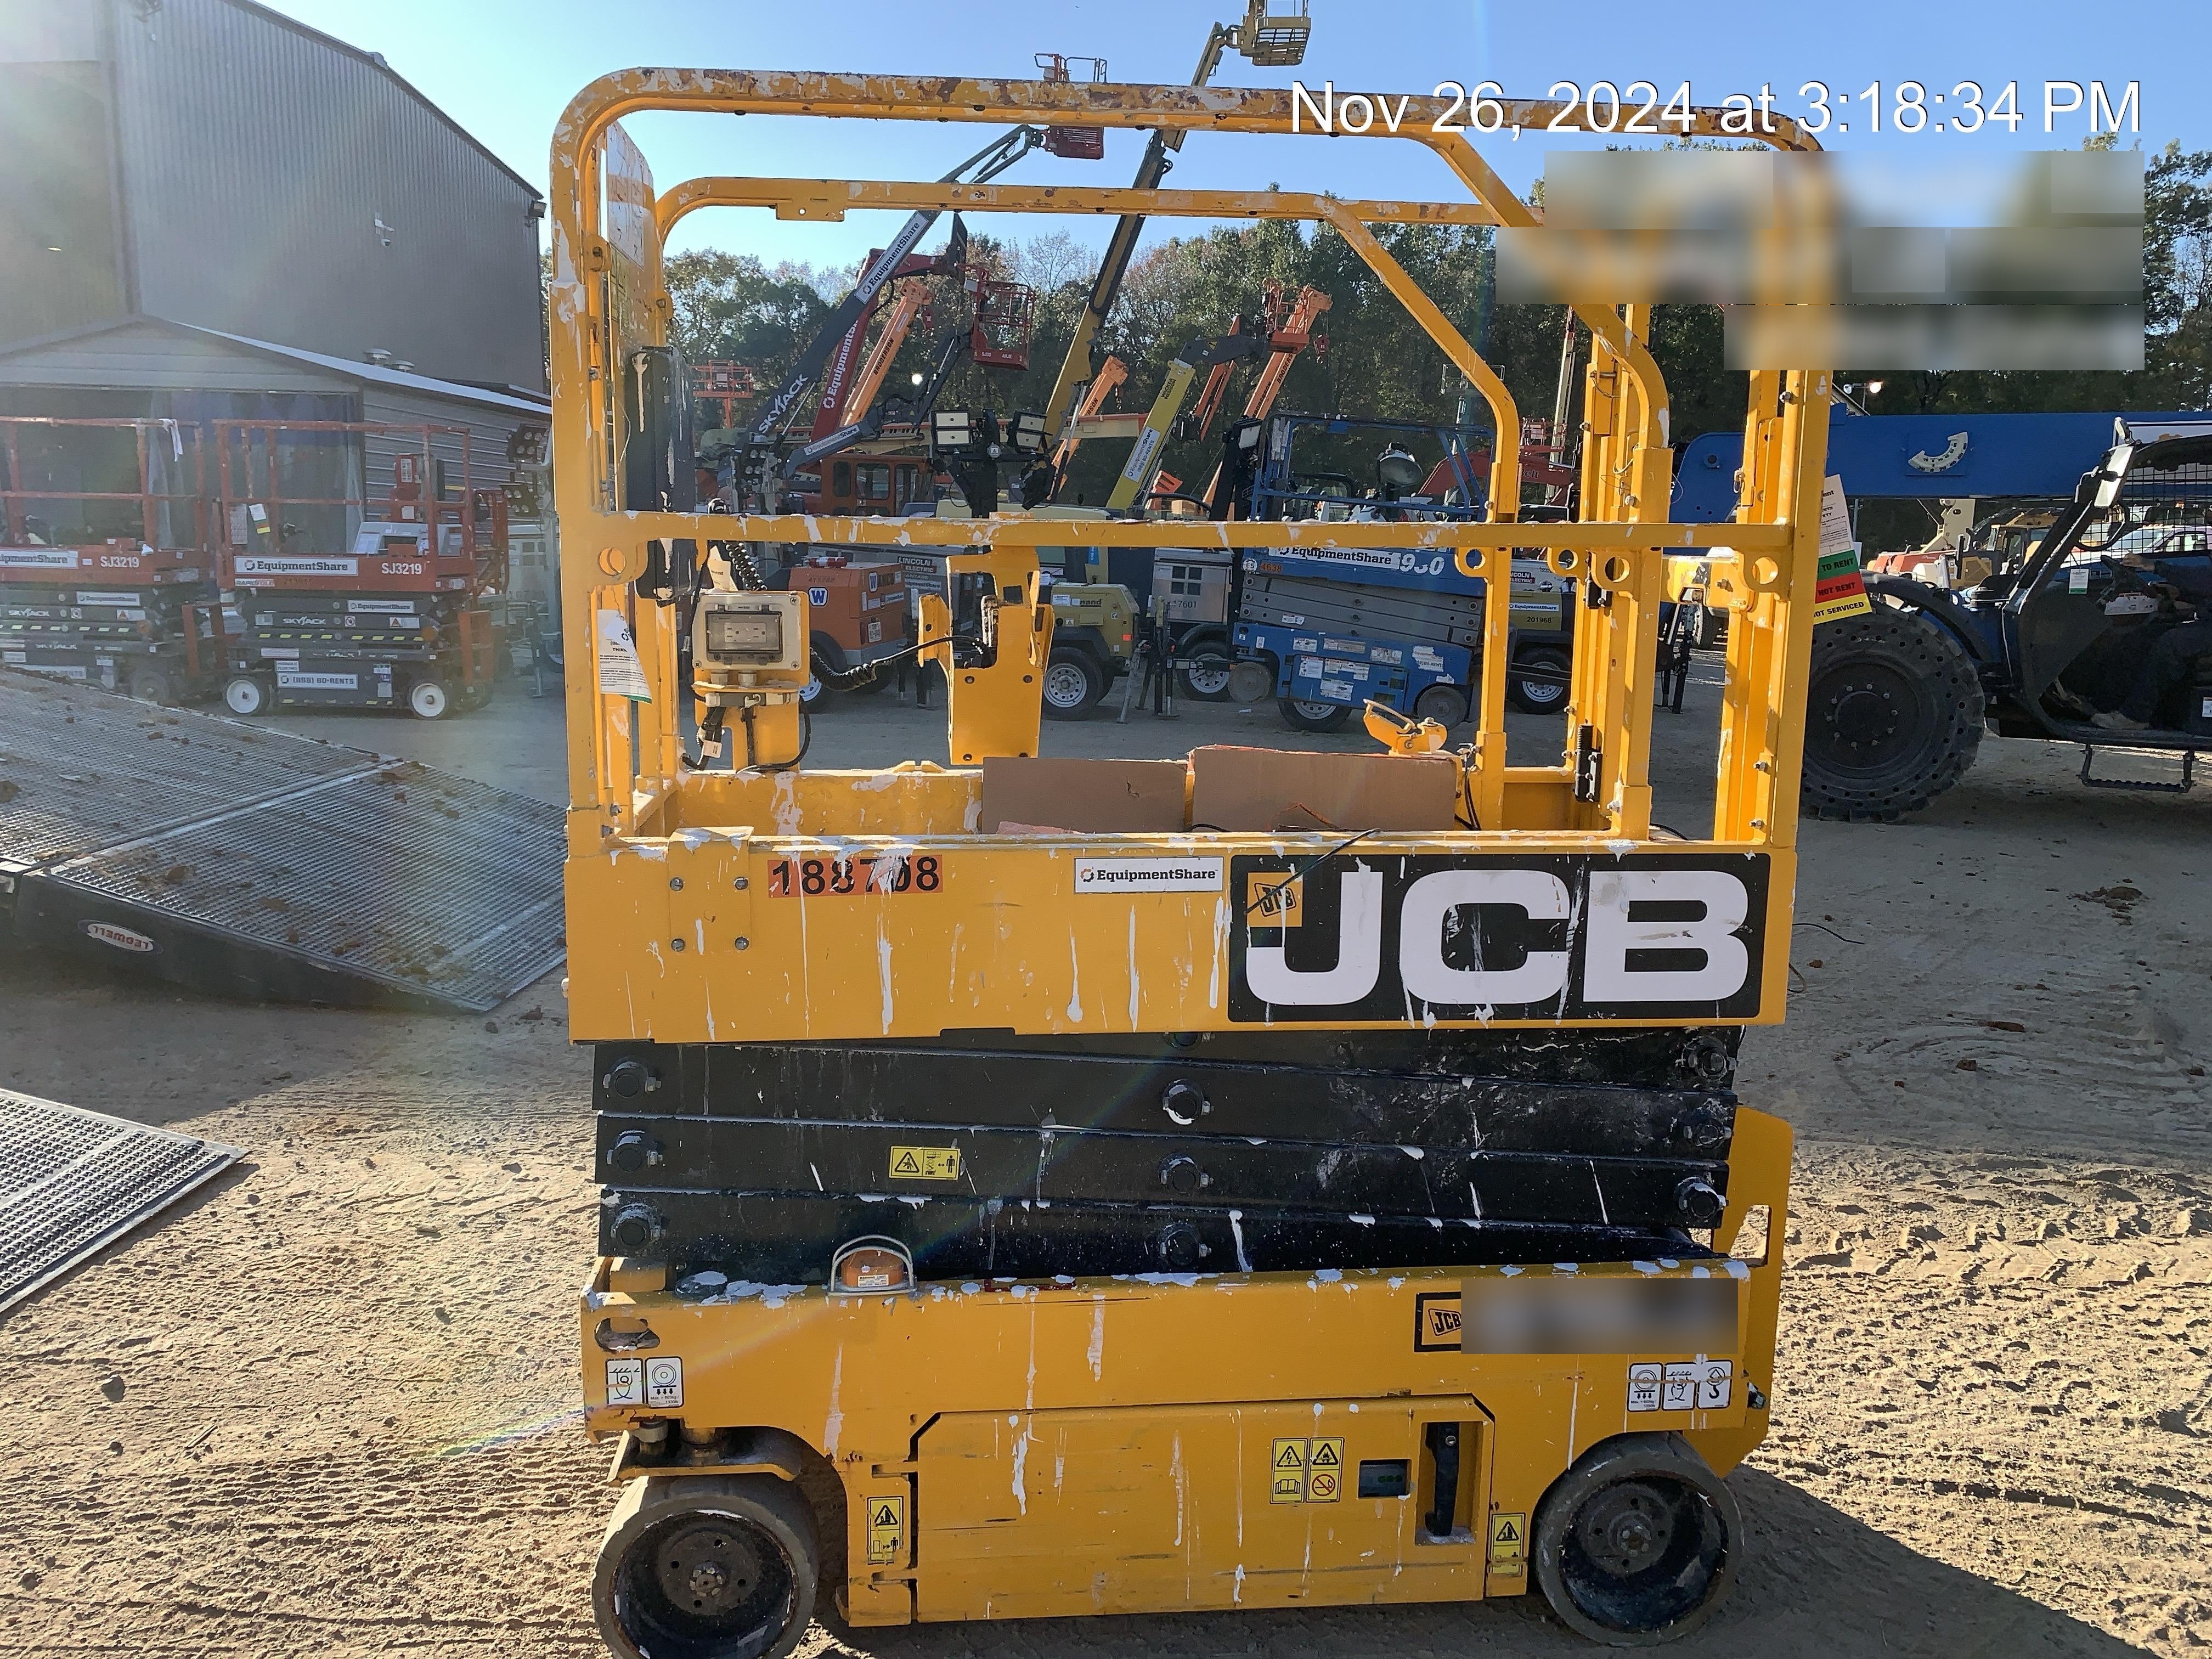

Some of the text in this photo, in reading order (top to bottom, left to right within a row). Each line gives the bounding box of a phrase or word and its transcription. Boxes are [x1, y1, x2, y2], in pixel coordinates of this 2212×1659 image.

[868, 222, 919, 286] EquipmentShare
[873, 337, 894, 375] BRODERSON
[1277, 353, 1293, 383] BRODERS
[758, 374, 809, 433] SKYJACK
[100, 556, 139, 568] SJ3219
[898, 557, 932, 566] LINCOLN
[1291, 547, 1392, 565] EquipmentShare
[257, 561, 348, 572] EquipmentShare
[381, 563, 422, 574] SJ3219
[1821, 557, 1854, 571] TO RENT
[1835, 582, 1855, 592] RENT
[1826, 601, 1864, 614] SERVICED
[283, 616, 326, 625] SKYJACK
[1097, 868, 1216, 883] EquipmentShare
[92, 925, 149, 950] LEDWELL
[1245, 870, 1749, 1006] JCB
[1434, 1311, 1462, 1333] JCB
